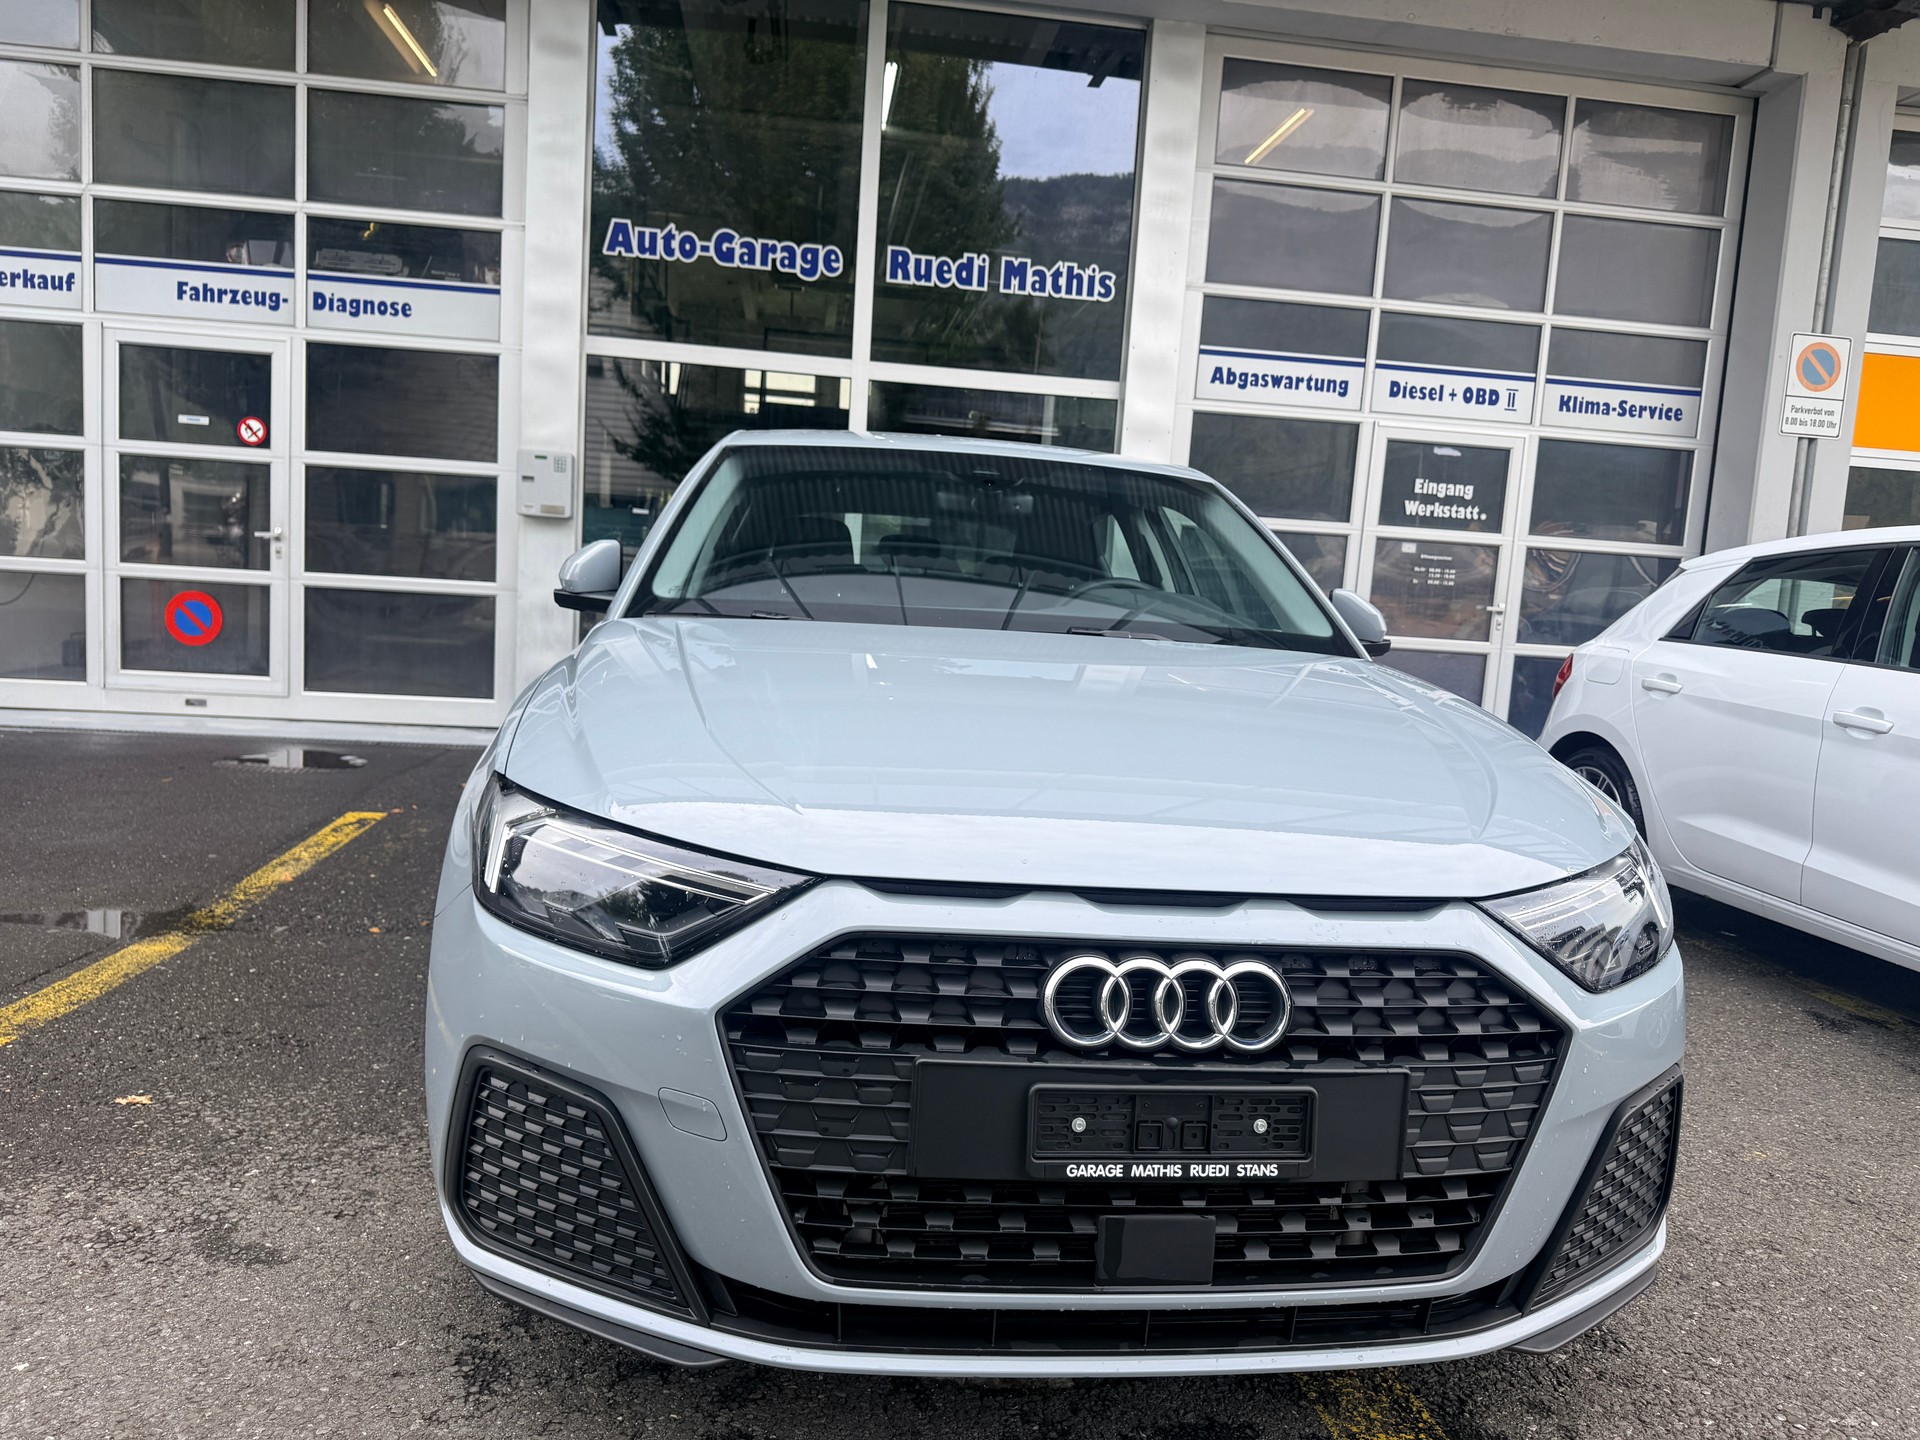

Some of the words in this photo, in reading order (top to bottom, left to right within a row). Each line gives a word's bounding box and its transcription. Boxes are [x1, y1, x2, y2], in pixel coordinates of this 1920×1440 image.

[603, 218, 844, 282] Auto-Garage
[886, 246, 989, 291] Ruedi
[999, 257, 1116, 302] Mathis
[176, 281, 289, 310] Fahrzeug-
[313, 291, 413, 318] Diagnose
[1210, 366, 1349, 397] Abgaswartung
[1389, 380, 1444, 402] Diesel
[1449, 389, 1457, 401] +
[1463, 386, 1500, 406] OBD
[1558, 395, 1683, 422] Klima-Service
[1791, 405, 1823, 416] Parkverbot
[1785, 417, 1798, 426] 8.00
[1799, 418, 1808, 426] bis
[1810, 419, 1825, 428] 18.00
[1826, 420, 1837, 429] Uhr
[1414, 478, 1474, 500] Eingang
[1404, 500, 1487, 521] Werkstatt.
[1066, 1163, 1124, 1178] GARAGE
[1130, 1163, 1182, 1178] MATHIS
[1189, 1163, 1230, 1178] RUEDI
[1236, 1163, 1279, 1178] STANS
